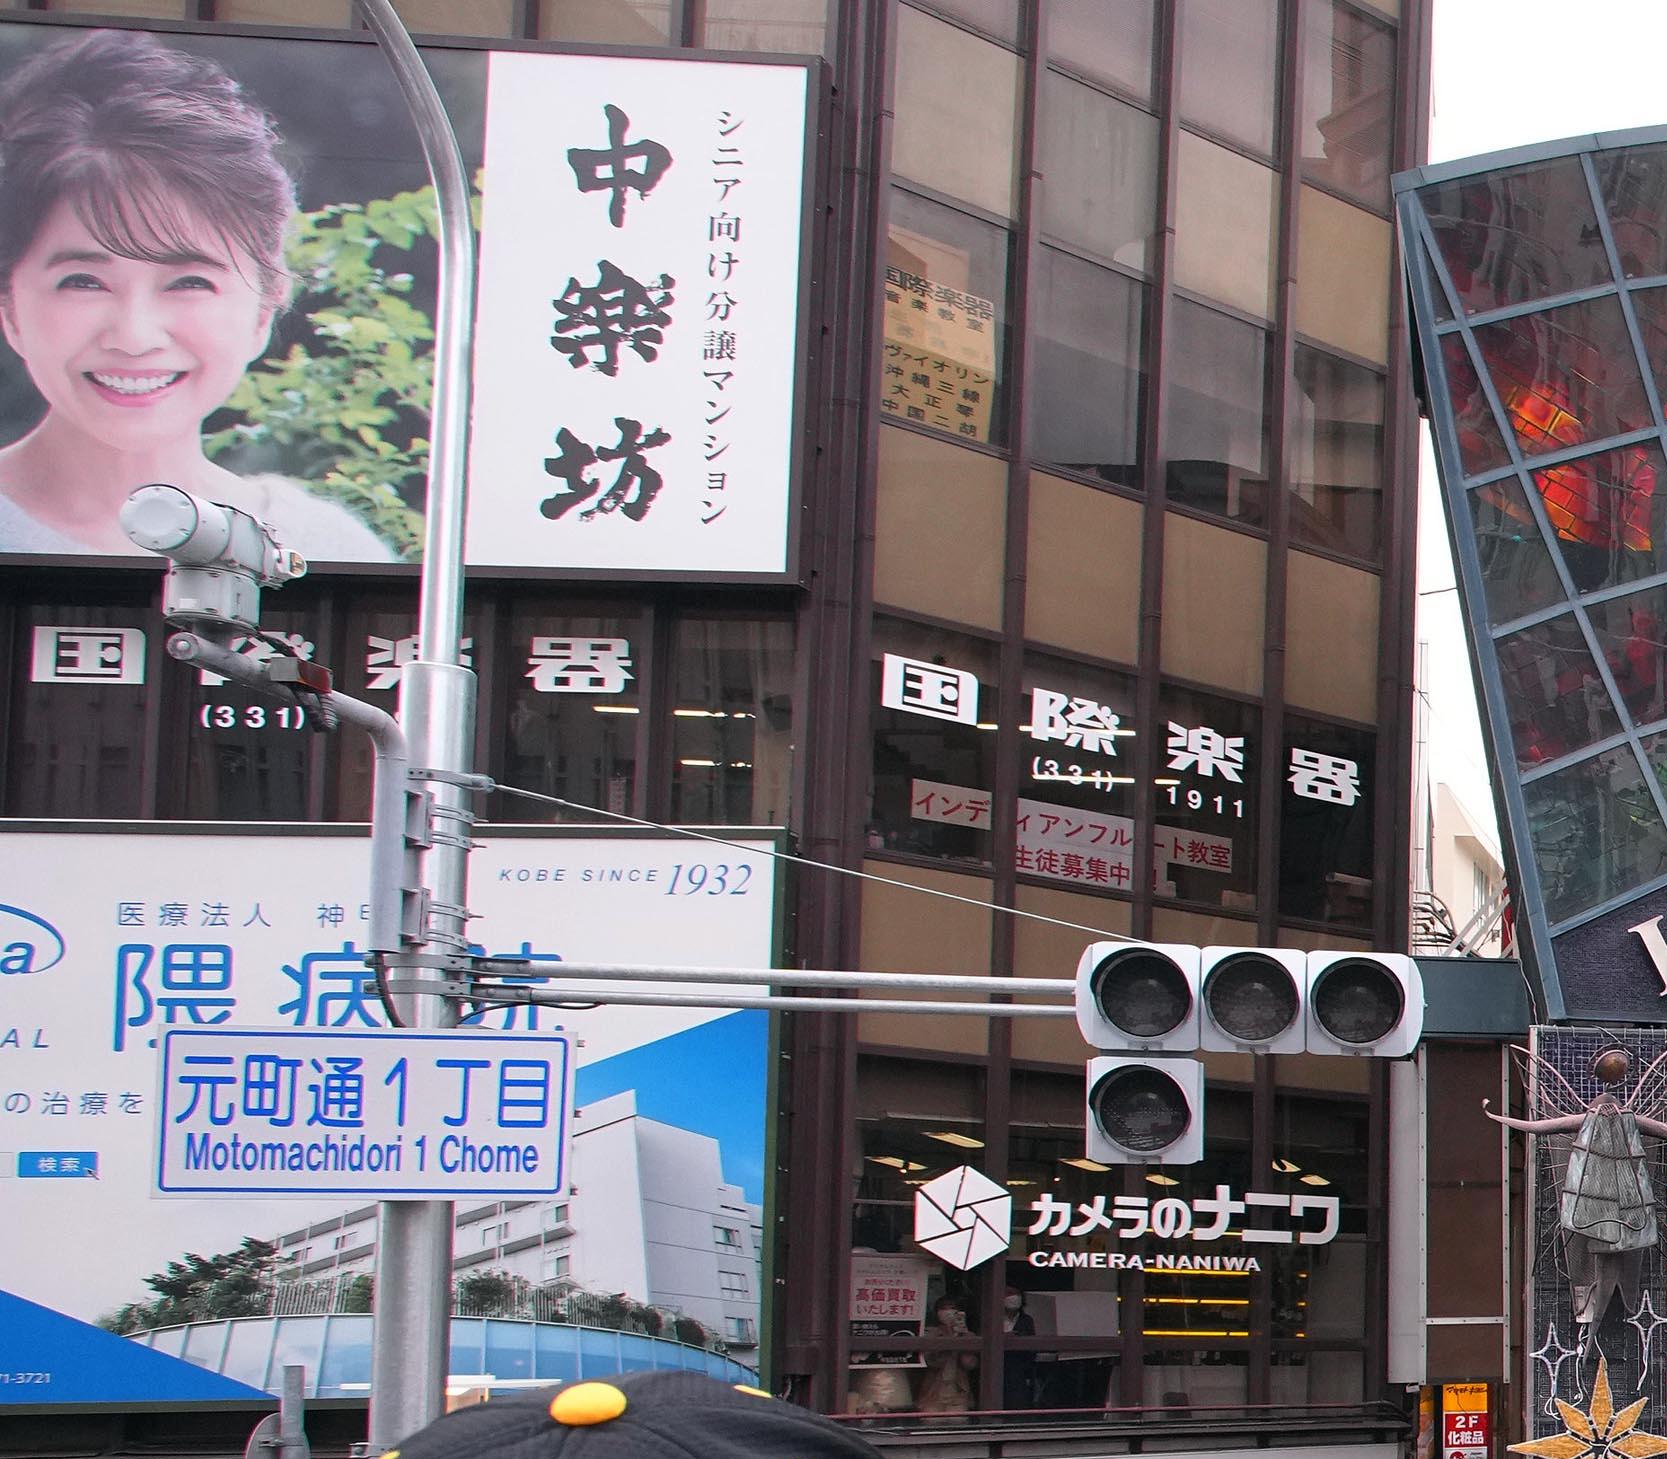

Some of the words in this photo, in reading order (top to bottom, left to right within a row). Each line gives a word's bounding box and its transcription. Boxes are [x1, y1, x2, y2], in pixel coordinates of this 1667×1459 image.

[699, 109, 743, 526] シニア向け分譲マンション
[201, 703, 306, 731] (331)
[881, 652, 1361, 806] 国際楽器
[1166, 785, 1245, 819] 1911
[500, 866, 567, 884] KOBE
[581, 867, 660, 885] SINCE
[664, 862, 754, 897] 1932
[117, 901, 272, 928] 医療法人
[317, 902, 370, 928] 神
[2, 1090, 144, 1116] の治療を
[175, 1054, 551, 1128] 元町通1丁目
[38, 1156, 82, 1174] 検索
[185, 1132, 402, 1172] Motomachidori
[414, 1136, 429, 1172] 1
[439, 1135, 539, 1174] Chome
[1028, 1184, 1341, 1245] カメラのナニワ
[1028, 1249, 1262, 1273] CAMERA-NANIWA
[856, 1288, 916, 1302] 高価買取
[1455, 1415, 1479, 1428] 2F
[1447, 1430, 1484, 1446] 化粧品
